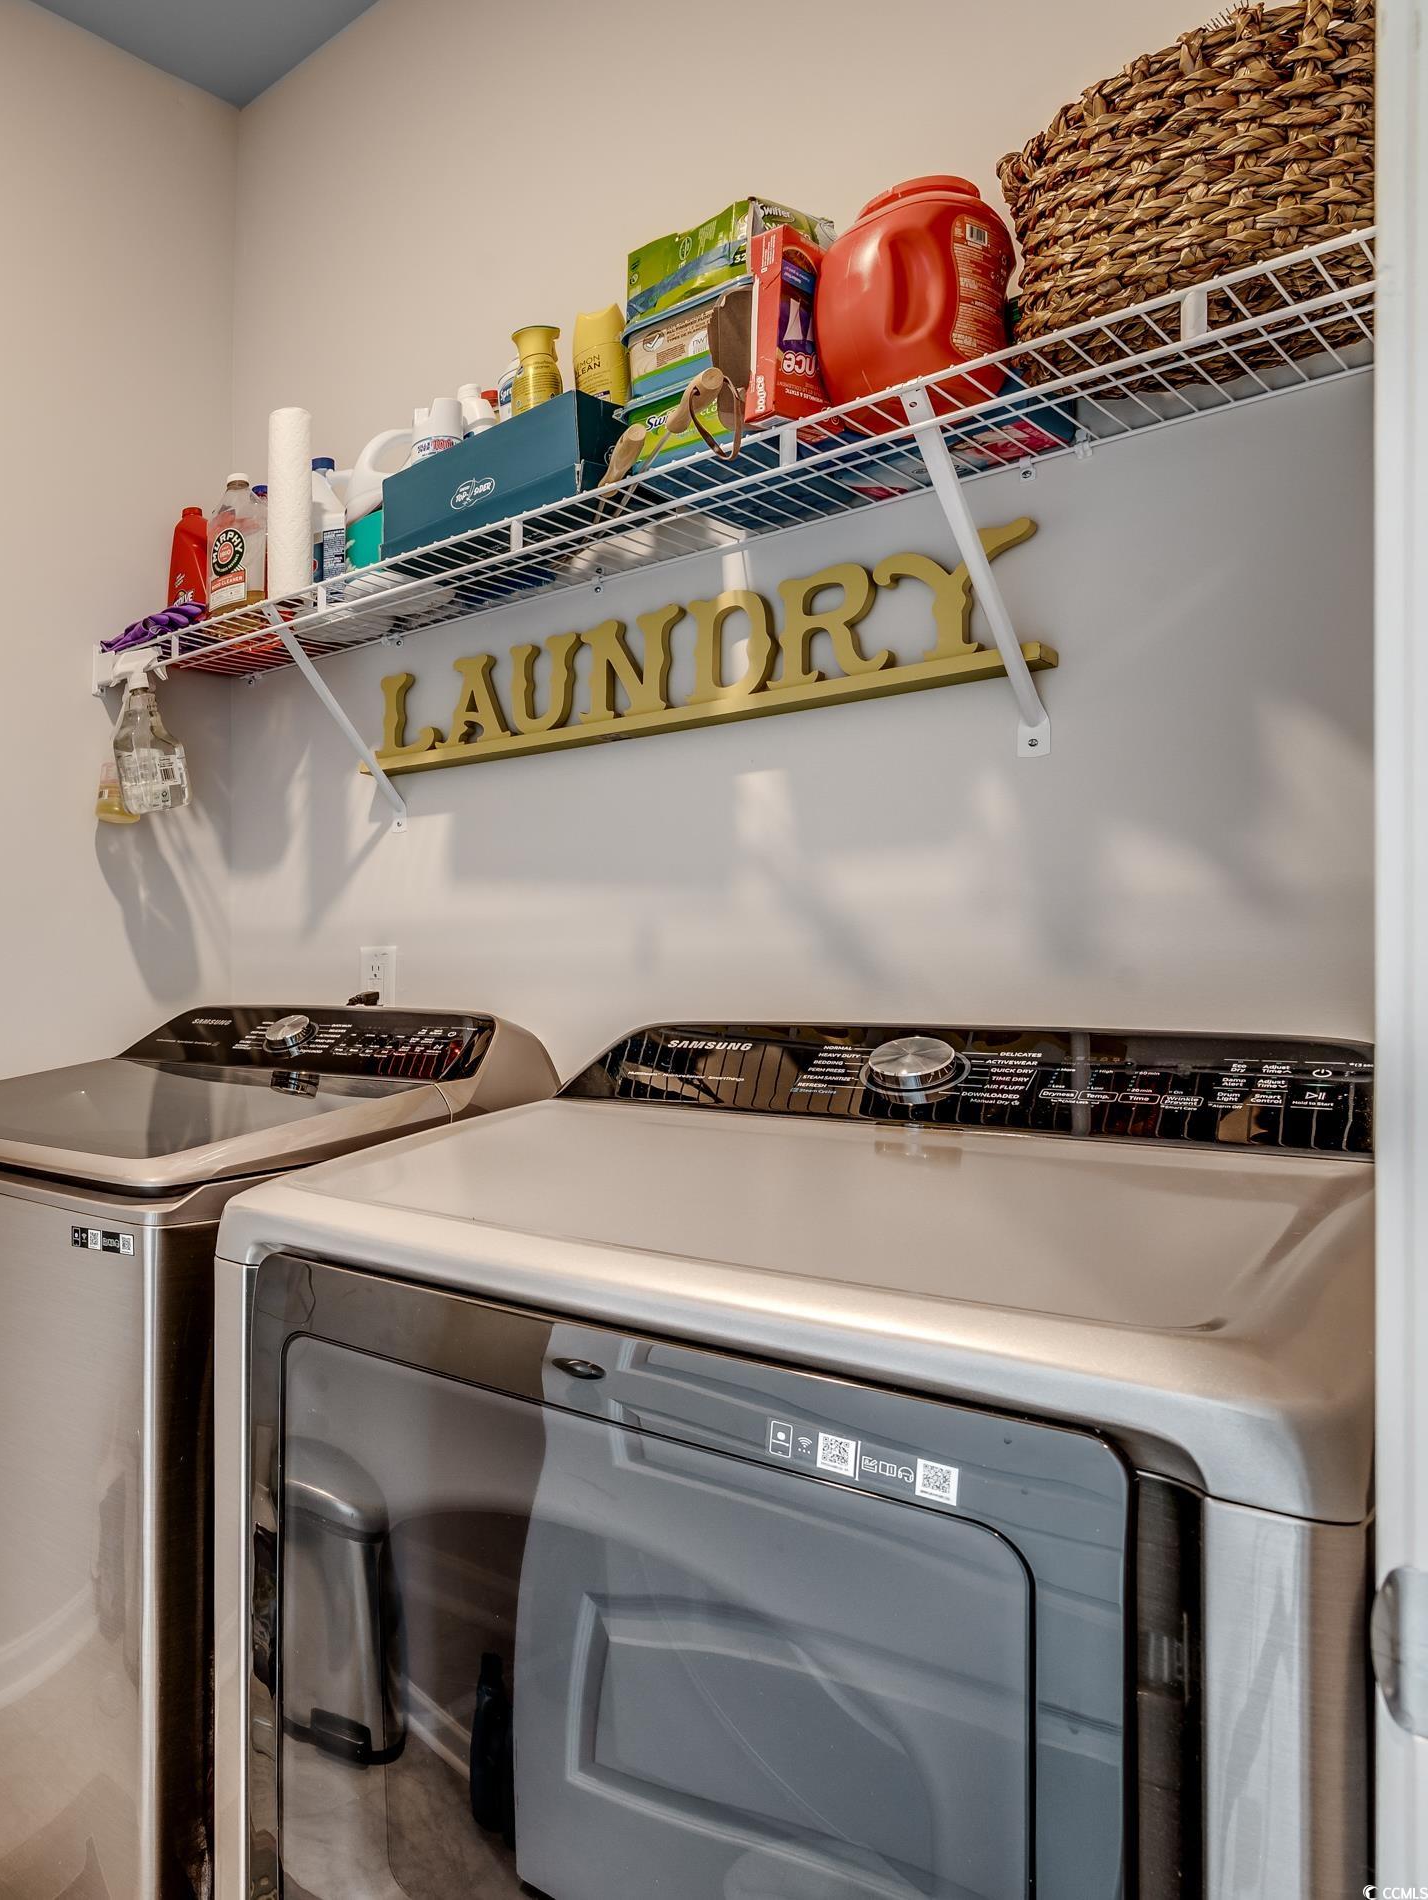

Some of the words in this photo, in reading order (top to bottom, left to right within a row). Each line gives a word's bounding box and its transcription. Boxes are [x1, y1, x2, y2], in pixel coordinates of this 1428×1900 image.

[212, 531, 243, 563] MURPHY
[375, 517, 1037, 759] LAUNDRY
[191, 1018, 232, 1026] SAMSUNG
[667, 1040, 753, 1051] SAMSUNG
[961, 1091, 1020, 1099] DOWNLOADED
